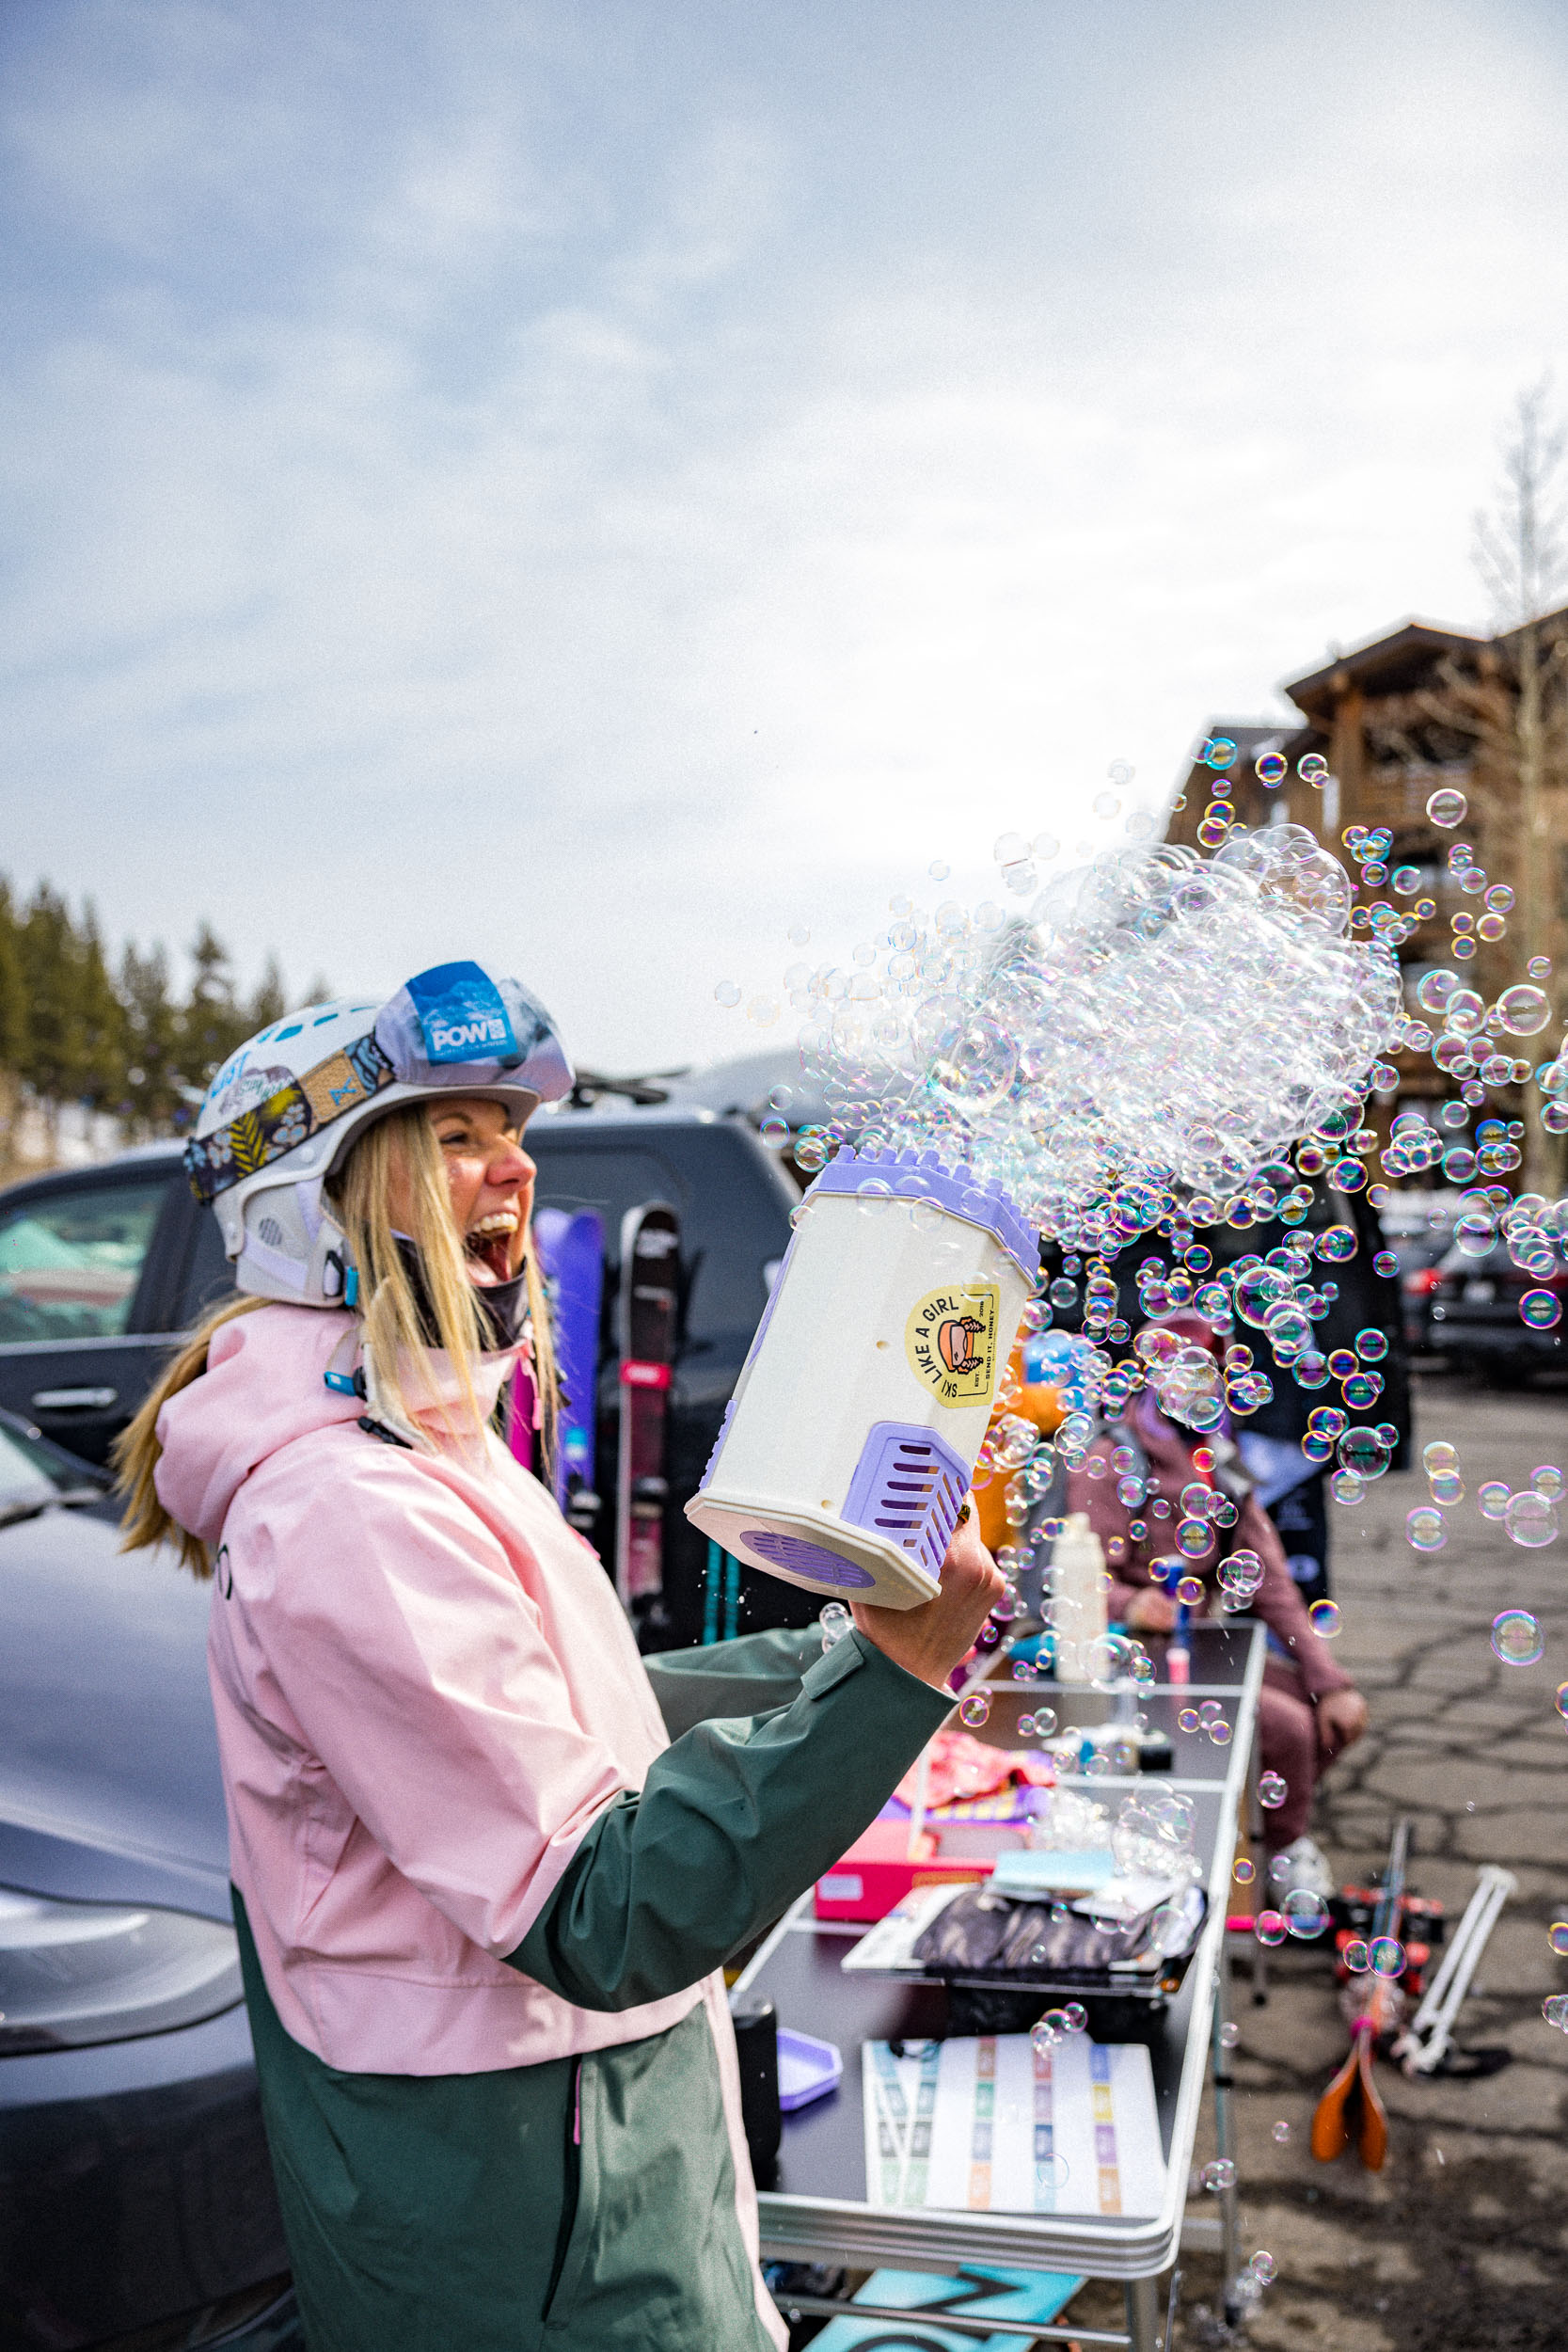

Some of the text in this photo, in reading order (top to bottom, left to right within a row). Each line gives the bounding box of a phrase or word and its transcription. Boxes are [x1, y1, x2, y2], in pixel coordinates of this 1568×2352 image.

[433, 1021, 487, 1051] POW
[915, 1296, 959, 1398] SKI LIKE A GIRL
